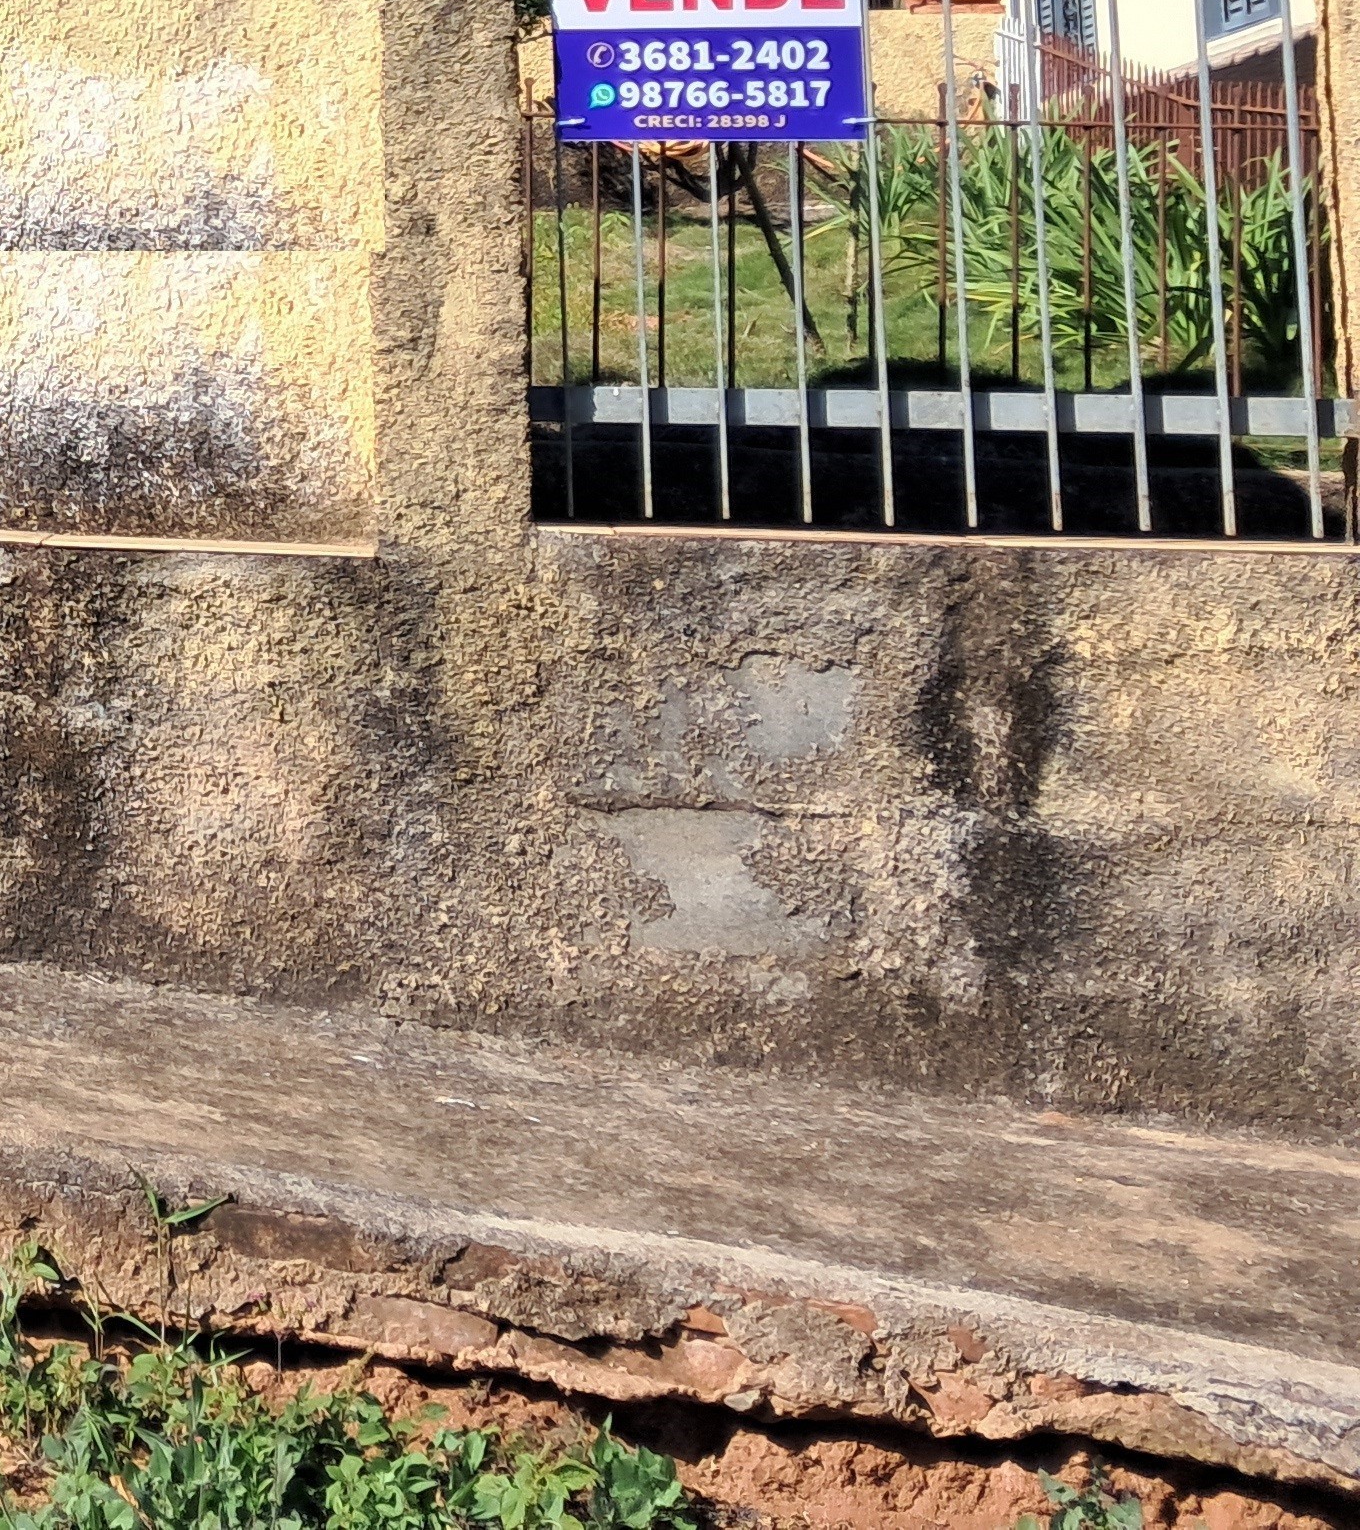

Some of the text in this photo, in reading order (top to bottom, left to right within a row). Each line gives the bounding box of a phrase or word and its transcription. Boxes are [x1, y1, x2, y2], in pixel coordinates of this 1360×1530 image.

[618, 40, 831, 71] 3681-2402
[619, 81, 831, 108] 98766-5817
[633, 115, 787, 128] CRECI: 28398 J
